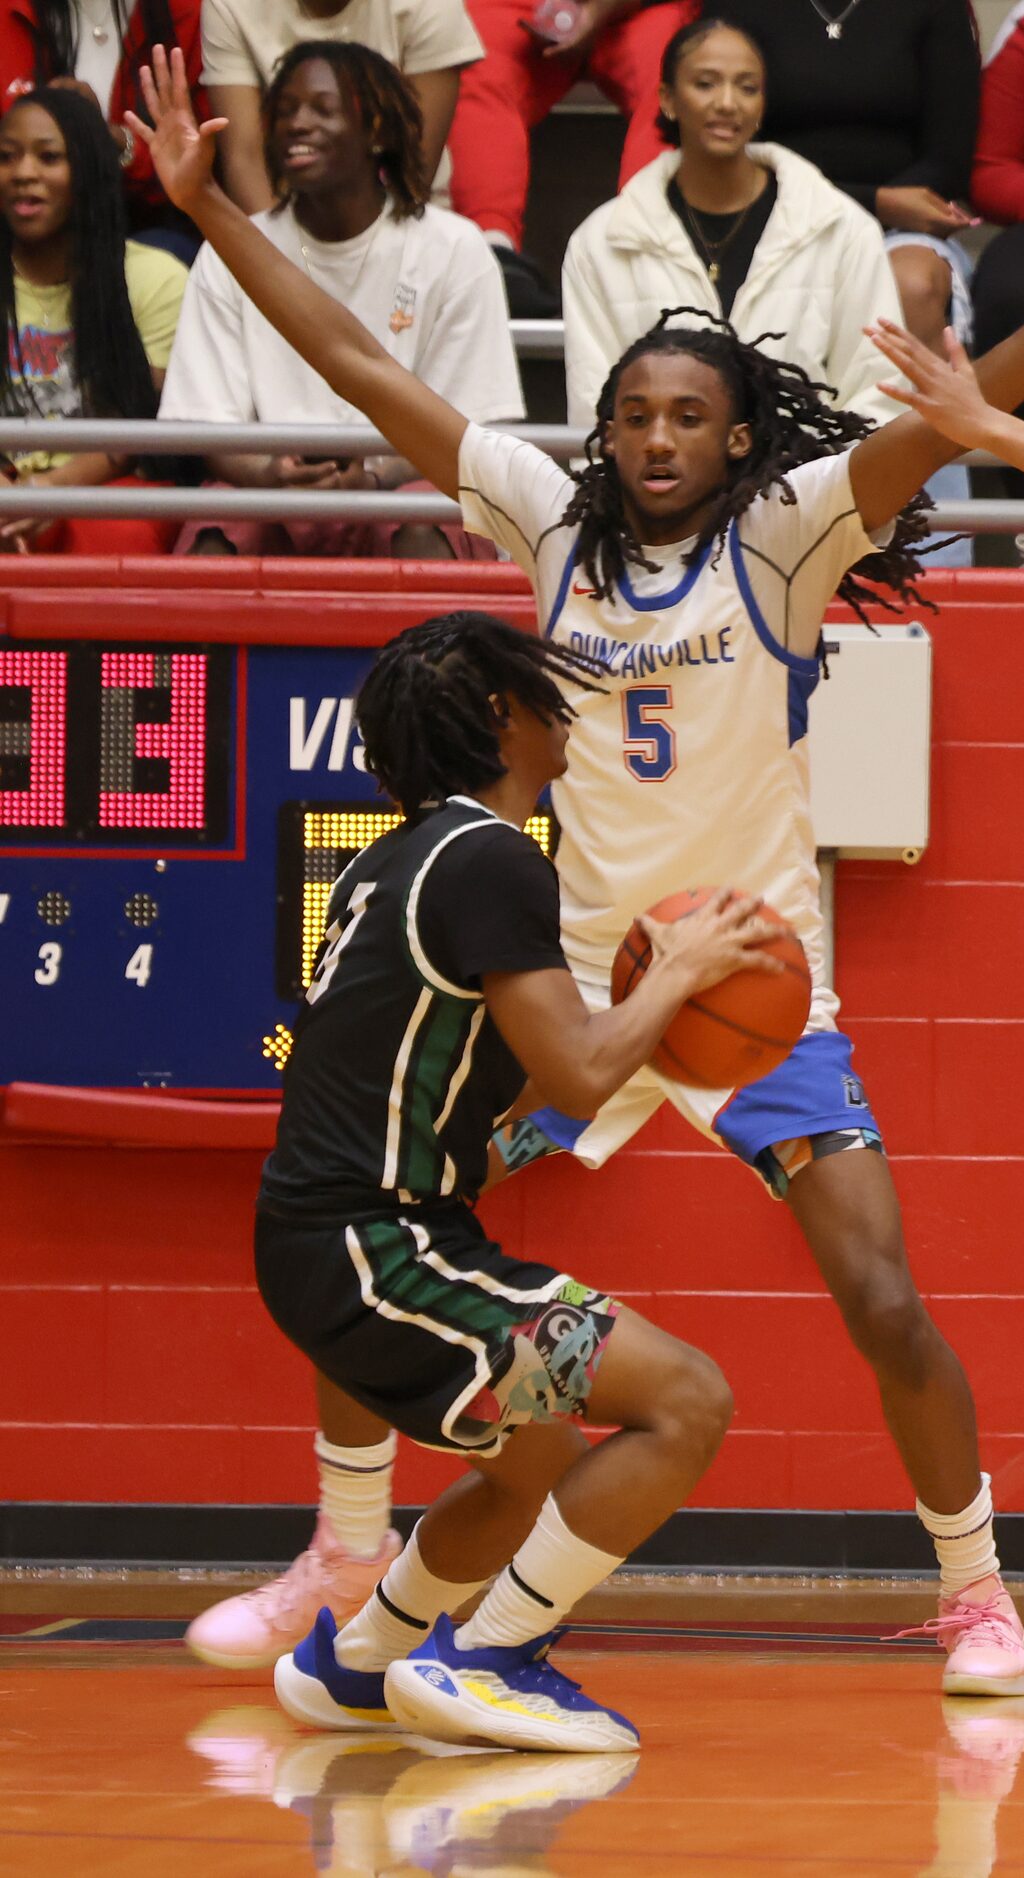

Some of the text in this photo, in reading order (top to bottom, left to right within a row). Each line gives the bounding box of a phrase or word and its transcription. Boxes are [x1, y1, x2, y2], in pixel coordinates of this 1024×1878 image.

[569, 626, 736, 679] DUNCANVILLE
[620, 684, 678, 783] 5
[35, 942, 153, 988] 3 4
